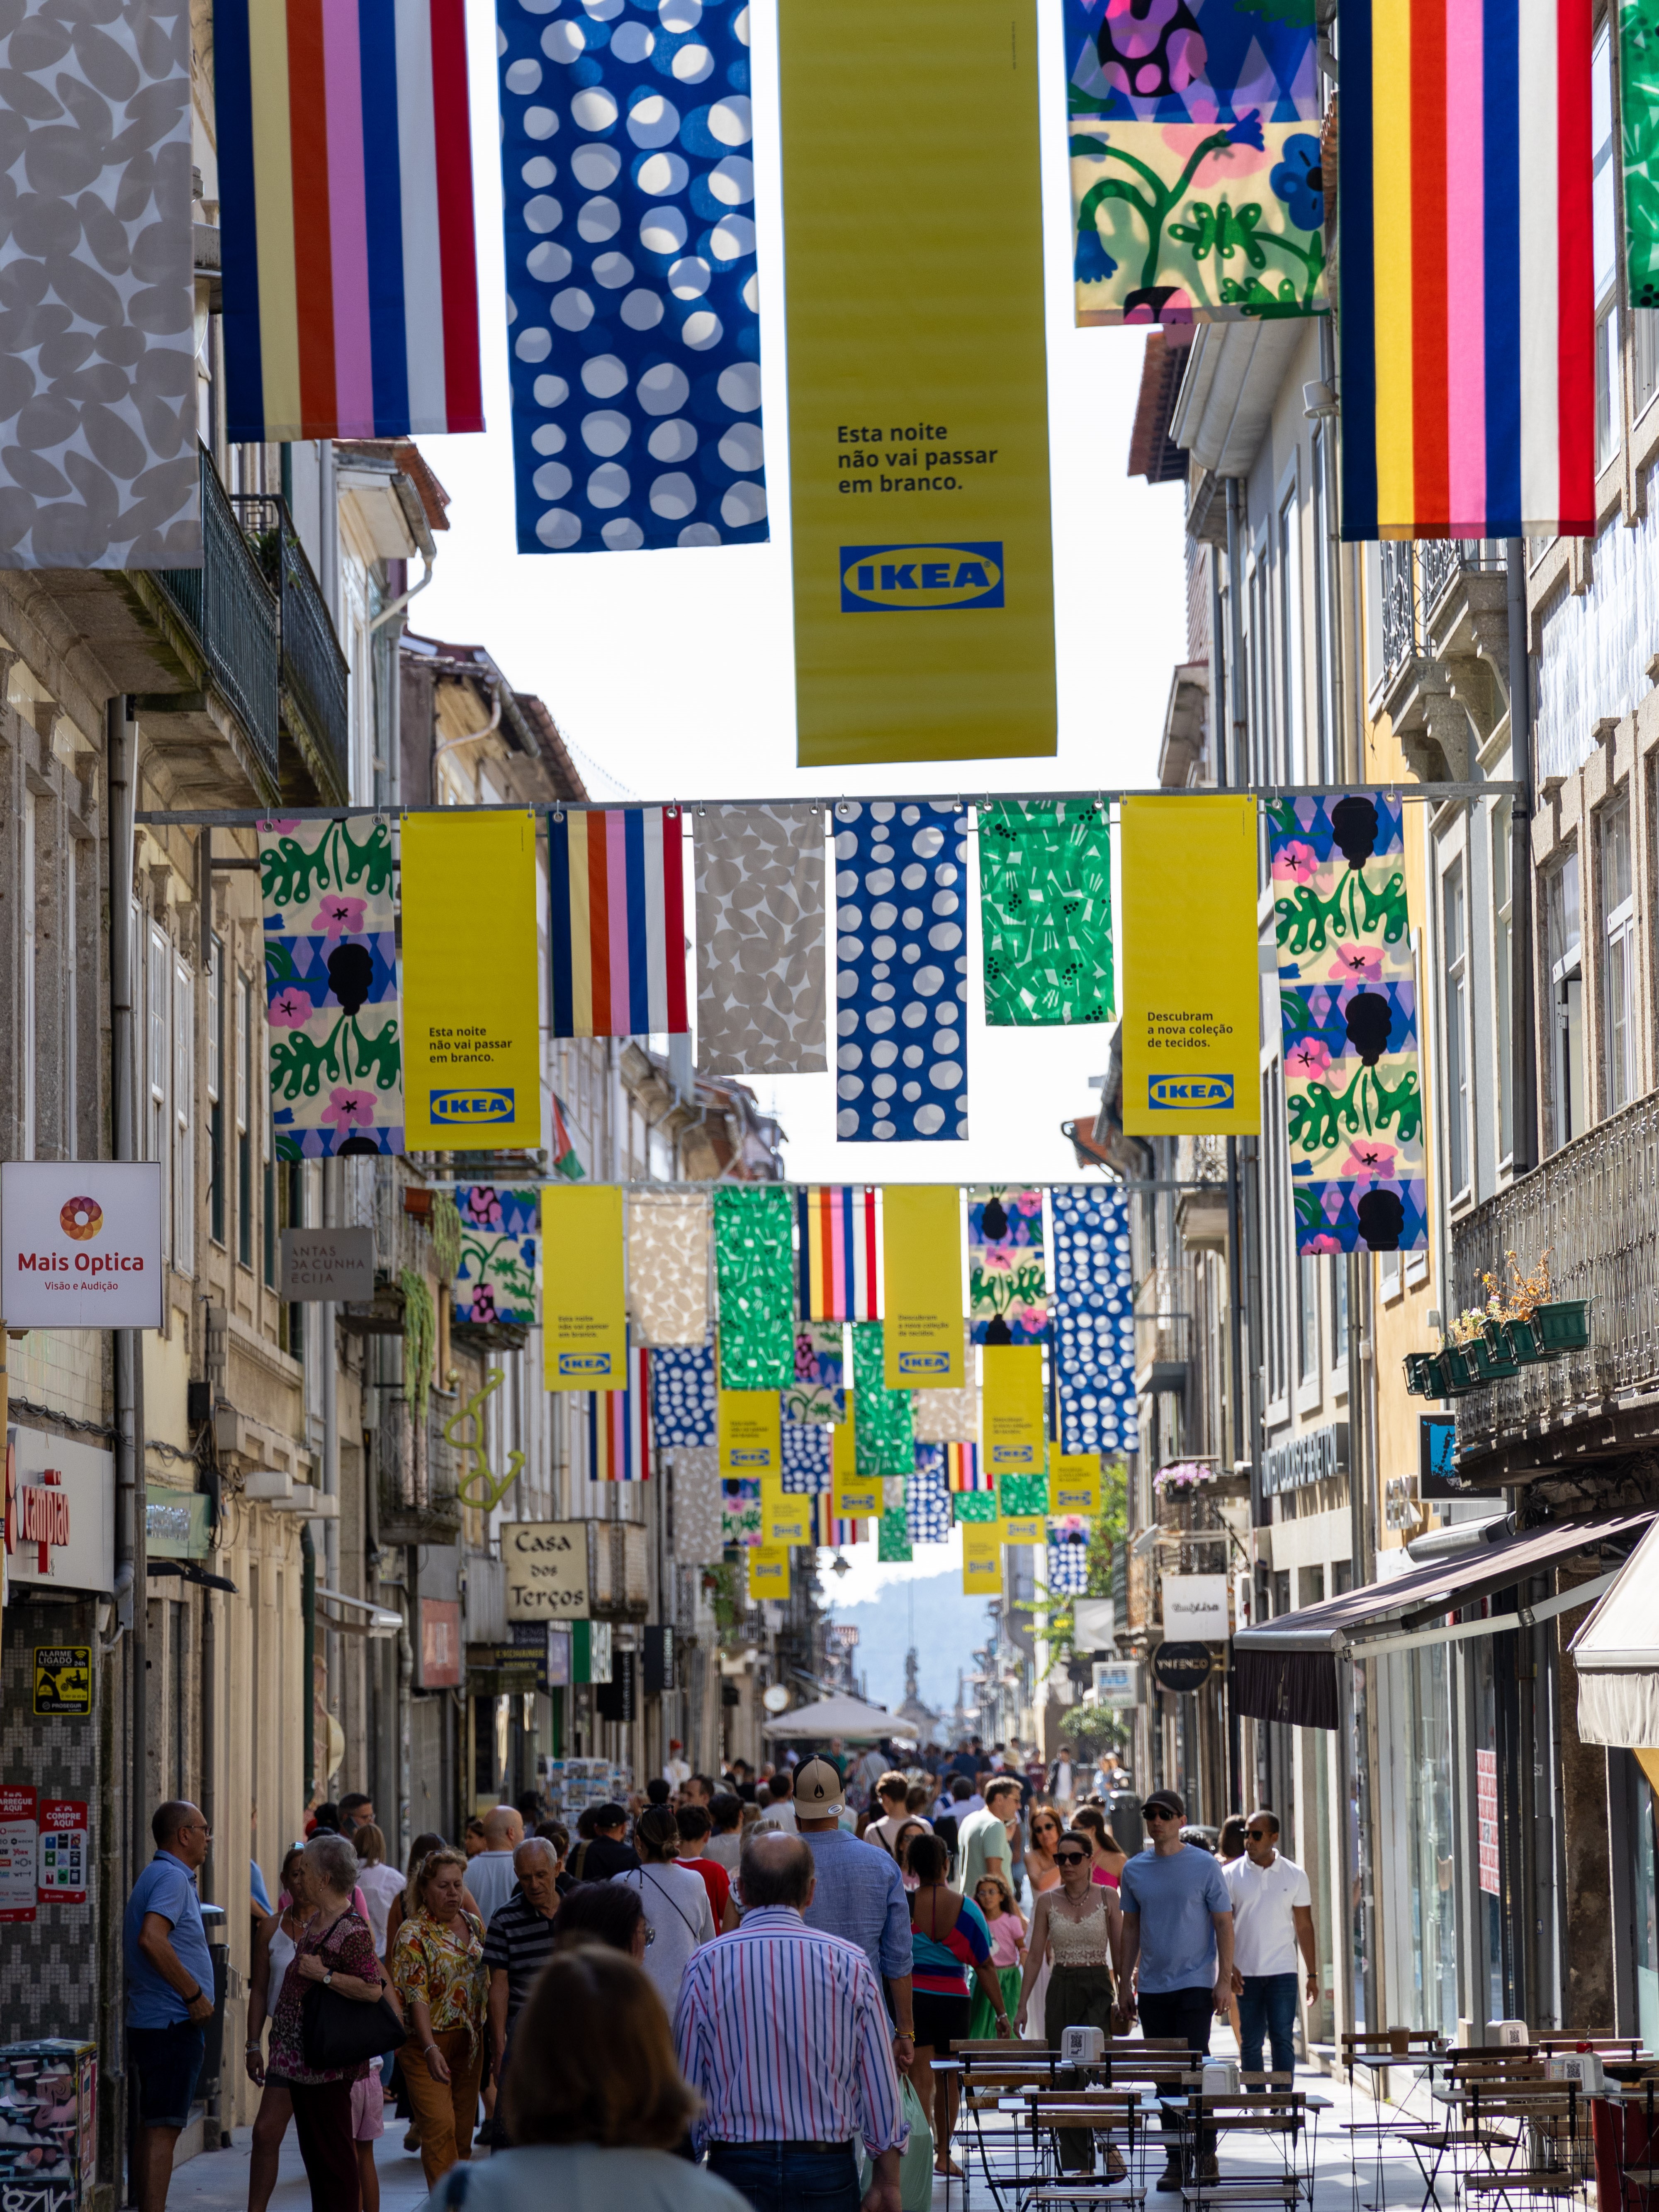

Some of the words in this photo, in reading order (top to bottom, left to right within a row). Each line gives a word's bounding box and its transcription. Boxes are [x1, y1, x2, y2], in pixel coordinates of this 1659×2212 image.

[838, 426, 882, 443] Esta
[890, 423, 947, 442] noite
[838, 450, 879, 468] não
[885, 449, 918, 467] vai
[925, 448, 998, 470] passar
[839, 478, 873, 493] em
[881, 475, 963, 492] branco.
[858, 562, 990, 591] IKEA
[1148, 1012, 1213, 1021] Descubram
[429, 1027, 453, 1037] Esta
[456, 1026, 487, 1036] noite
[1189, 1024, 1233, 1036] coleção
[430, 1040, 451, 1050] não
[454, 1039, 471, 1049] vai
[474, 1040, 513, 1051] passar
[1148, 1038, 1162, 1048] de
[1165, 1038, 1210, 1047] tecidos.
[430, 1054, 448, 1063] em
[451, 1053, 494, 1062] branco.
[1158, 1085, 1227, 1098] IKEA
[439, 1099, 508, 1113] IKEA
[18, 1252, 69, 1272] Mais
[75, 1252, 144, 1275] Optica
[312, 1259, 365, 1270] CUNHA
[44, 1281, 70, 1290] Visão
[80, 1281, 118, 1292] Audição
[564, 1359, 606, 1368] IKEA
[904, 1358, 945, 1367] IKEA
[515, 1531, 572, 1553] Casa
[530, 1564, 557, 1577] dos
[511, 1586, 584, 1612] Terços
